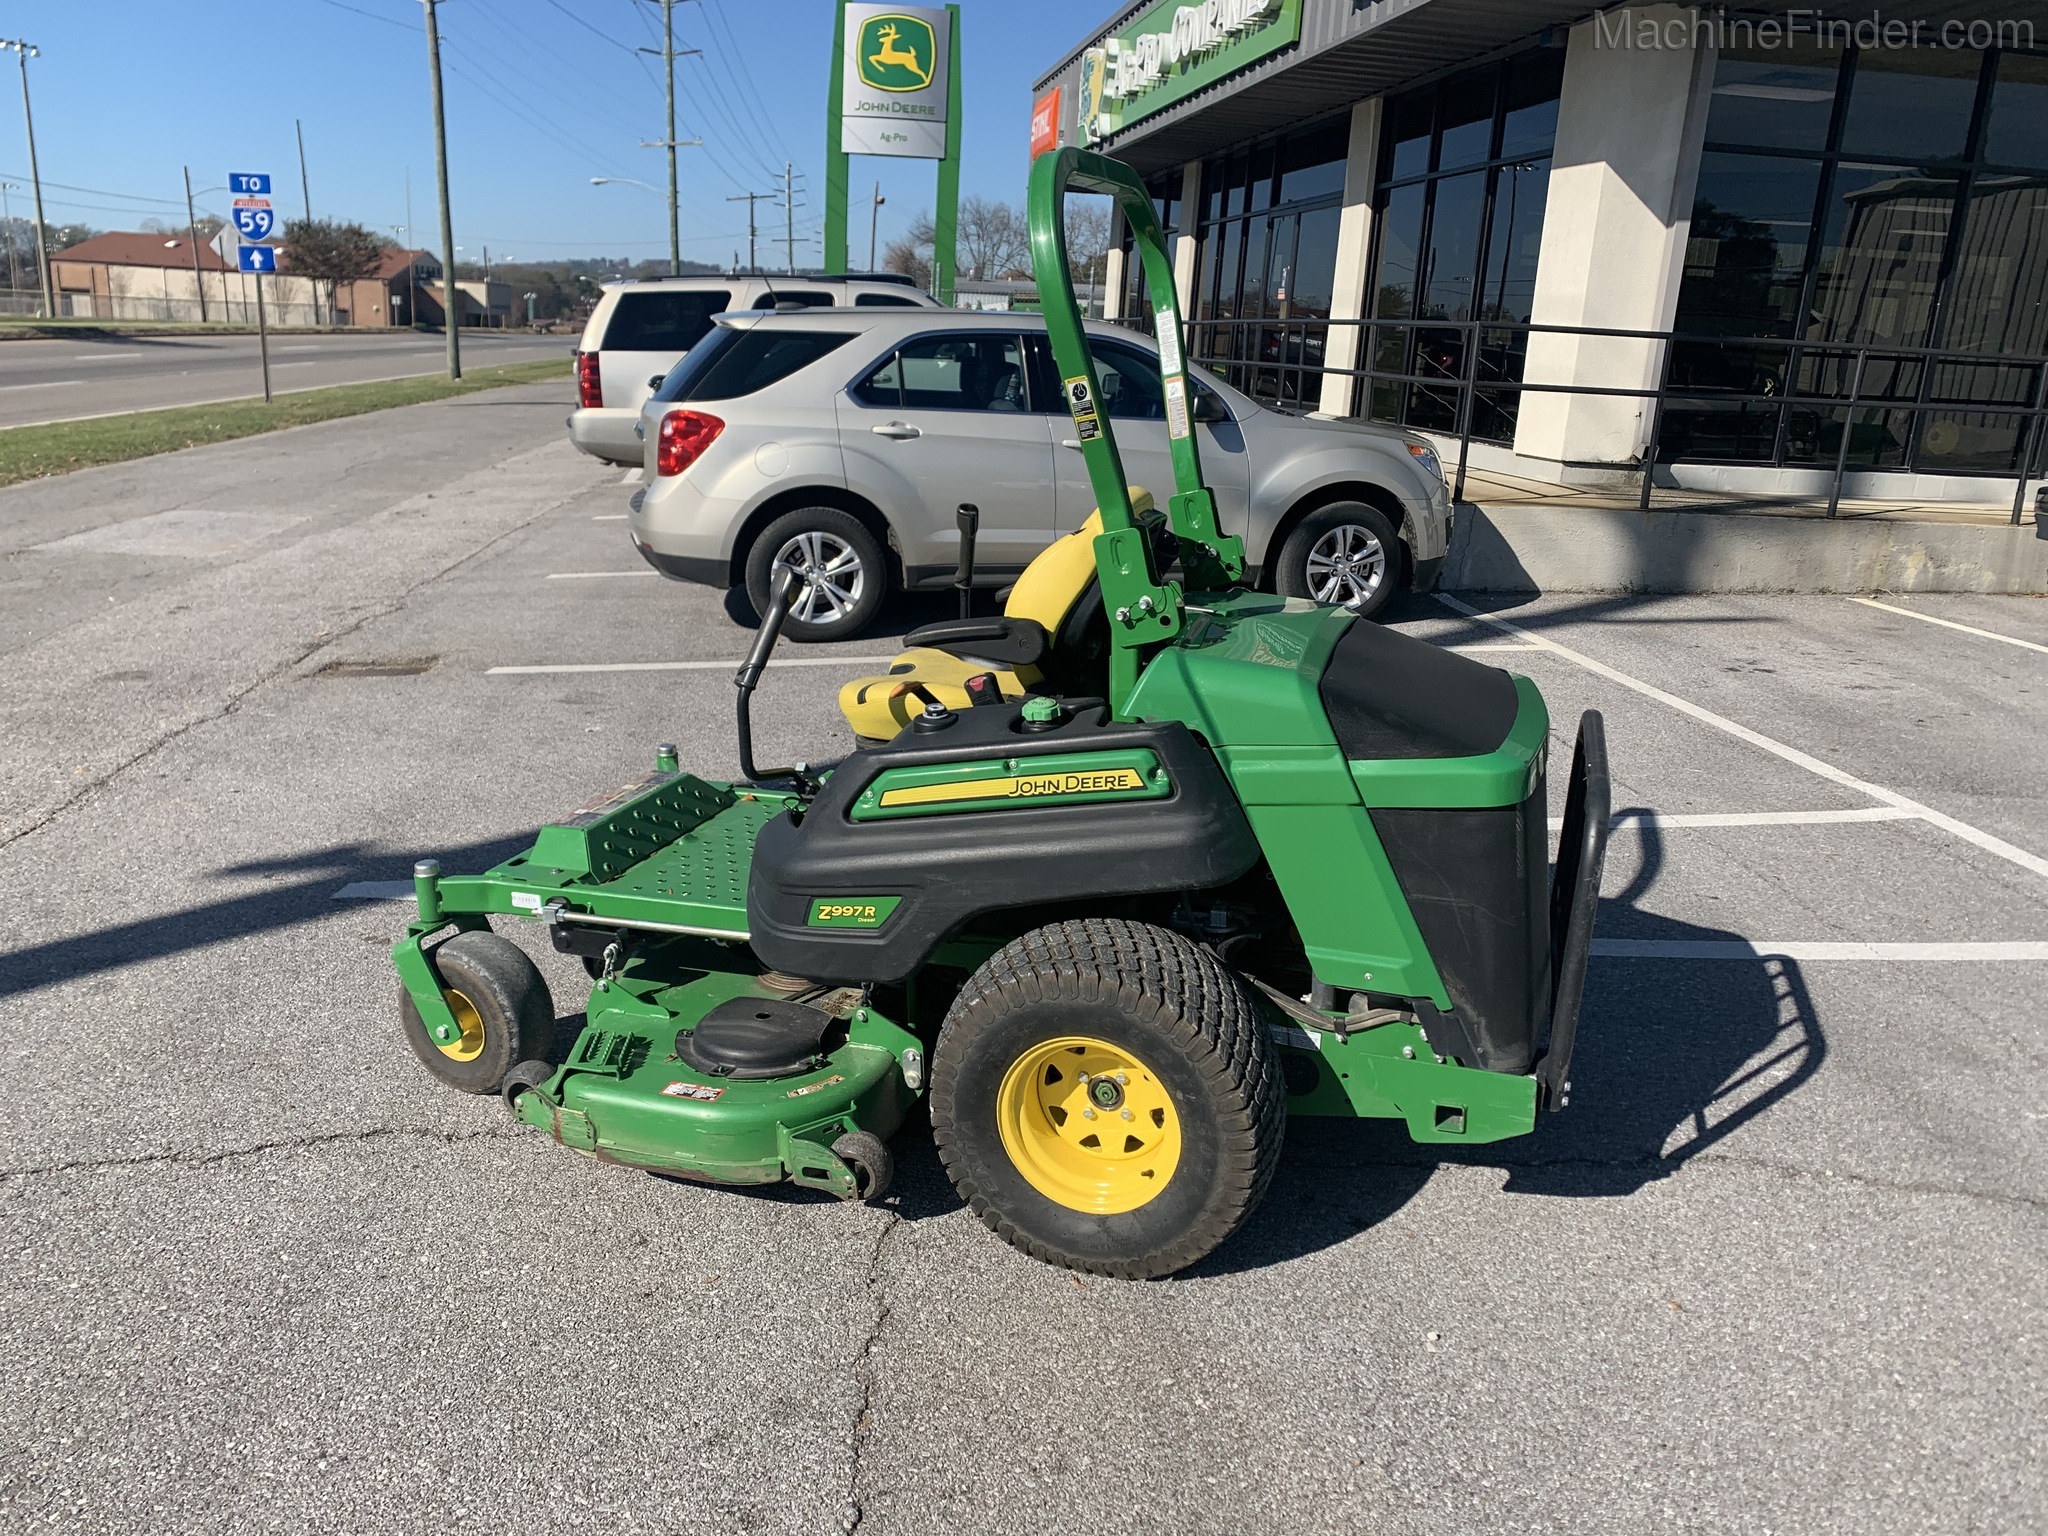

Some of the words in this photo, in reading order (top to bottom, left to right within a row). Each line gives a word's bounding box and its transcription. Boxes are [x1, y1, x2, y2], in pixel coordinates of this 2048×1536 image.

[1170, 0, 1268, 63] COMPANI
[855, 100, 890, 113] JOHN
[891, 101, 936, 116] DEERE
[1031, 107, 1051, 143] STIHL
[880, 132, 908, 143] Ag-Pro
[239, 176, 261, 192] TO
[240, 211, 269, 233] 59
[1009, 779, 1060, 796] JOHN
[1065, 775, 1130, 792] DEERE
